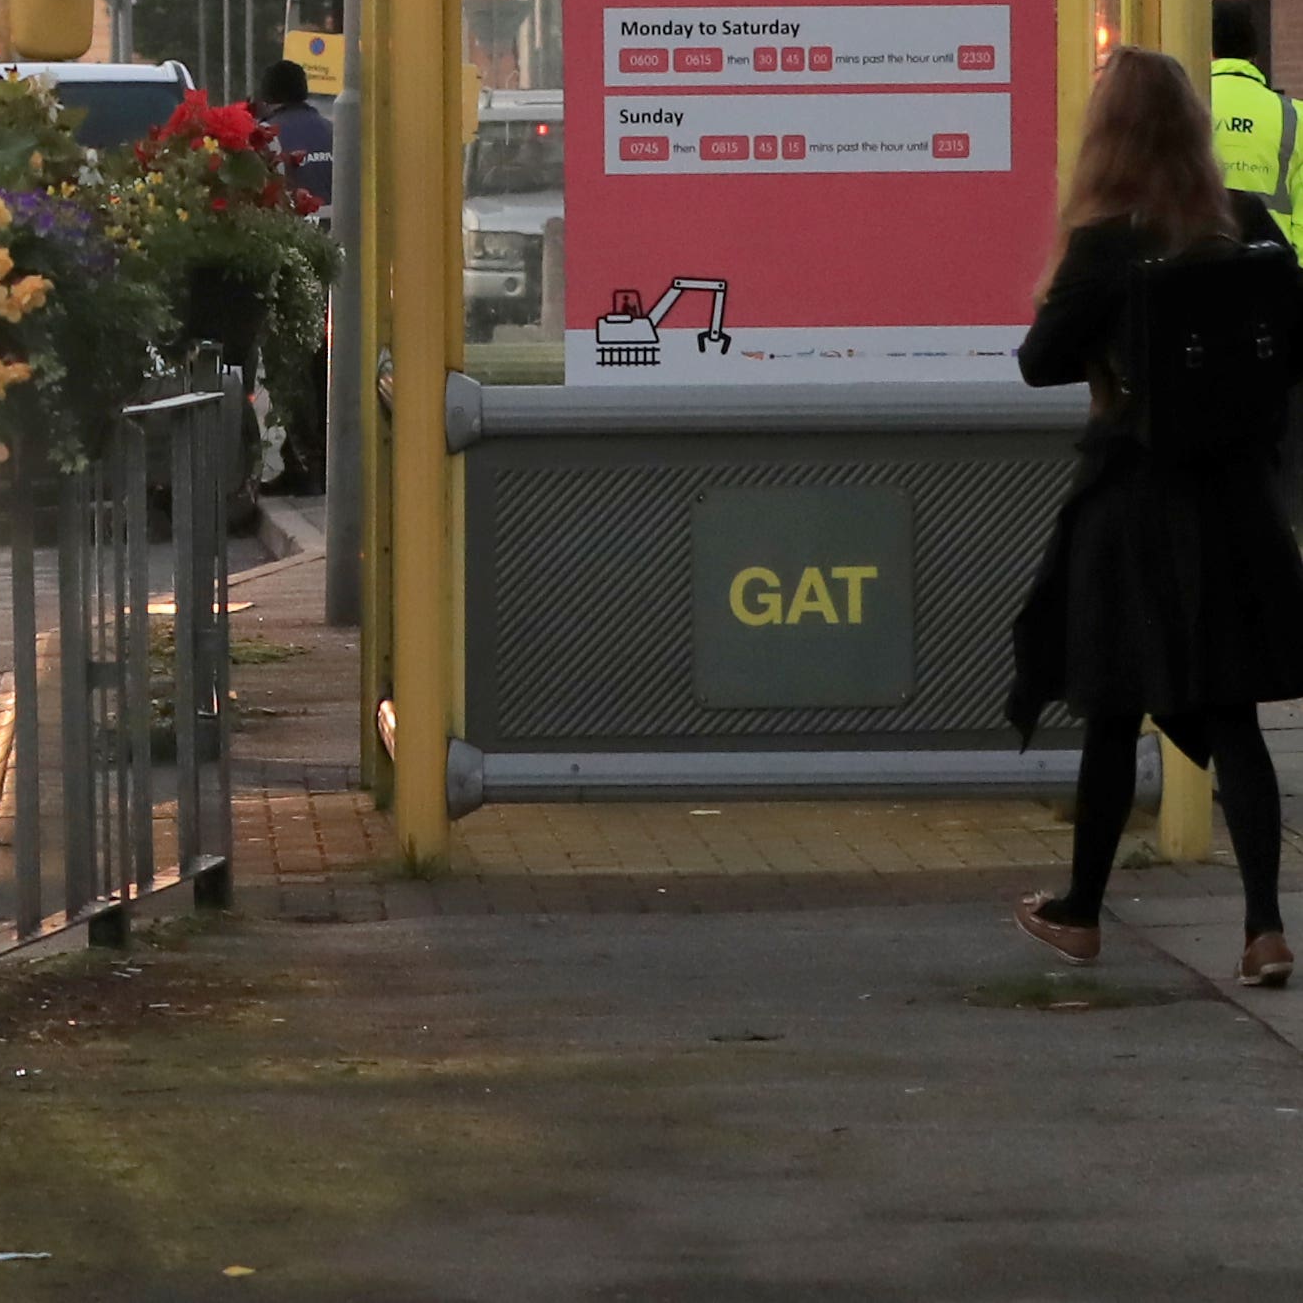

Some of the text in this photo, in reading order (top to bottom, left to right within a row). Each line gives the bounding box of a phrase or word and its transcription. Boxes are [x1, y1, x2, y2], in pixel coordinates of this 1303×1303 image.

[621, 20, 800, 38] Monday to Saturday
[629, 51, 991, 66] 0600 0615 then 30 45 00 mins past the hour until 2330
[619, 108, 684, 126] Sunday
[630, 140, 963, 154] 0745 then 0815 45 15 mins past the hour until 2315
[729, 566, 878, 626] GAT
